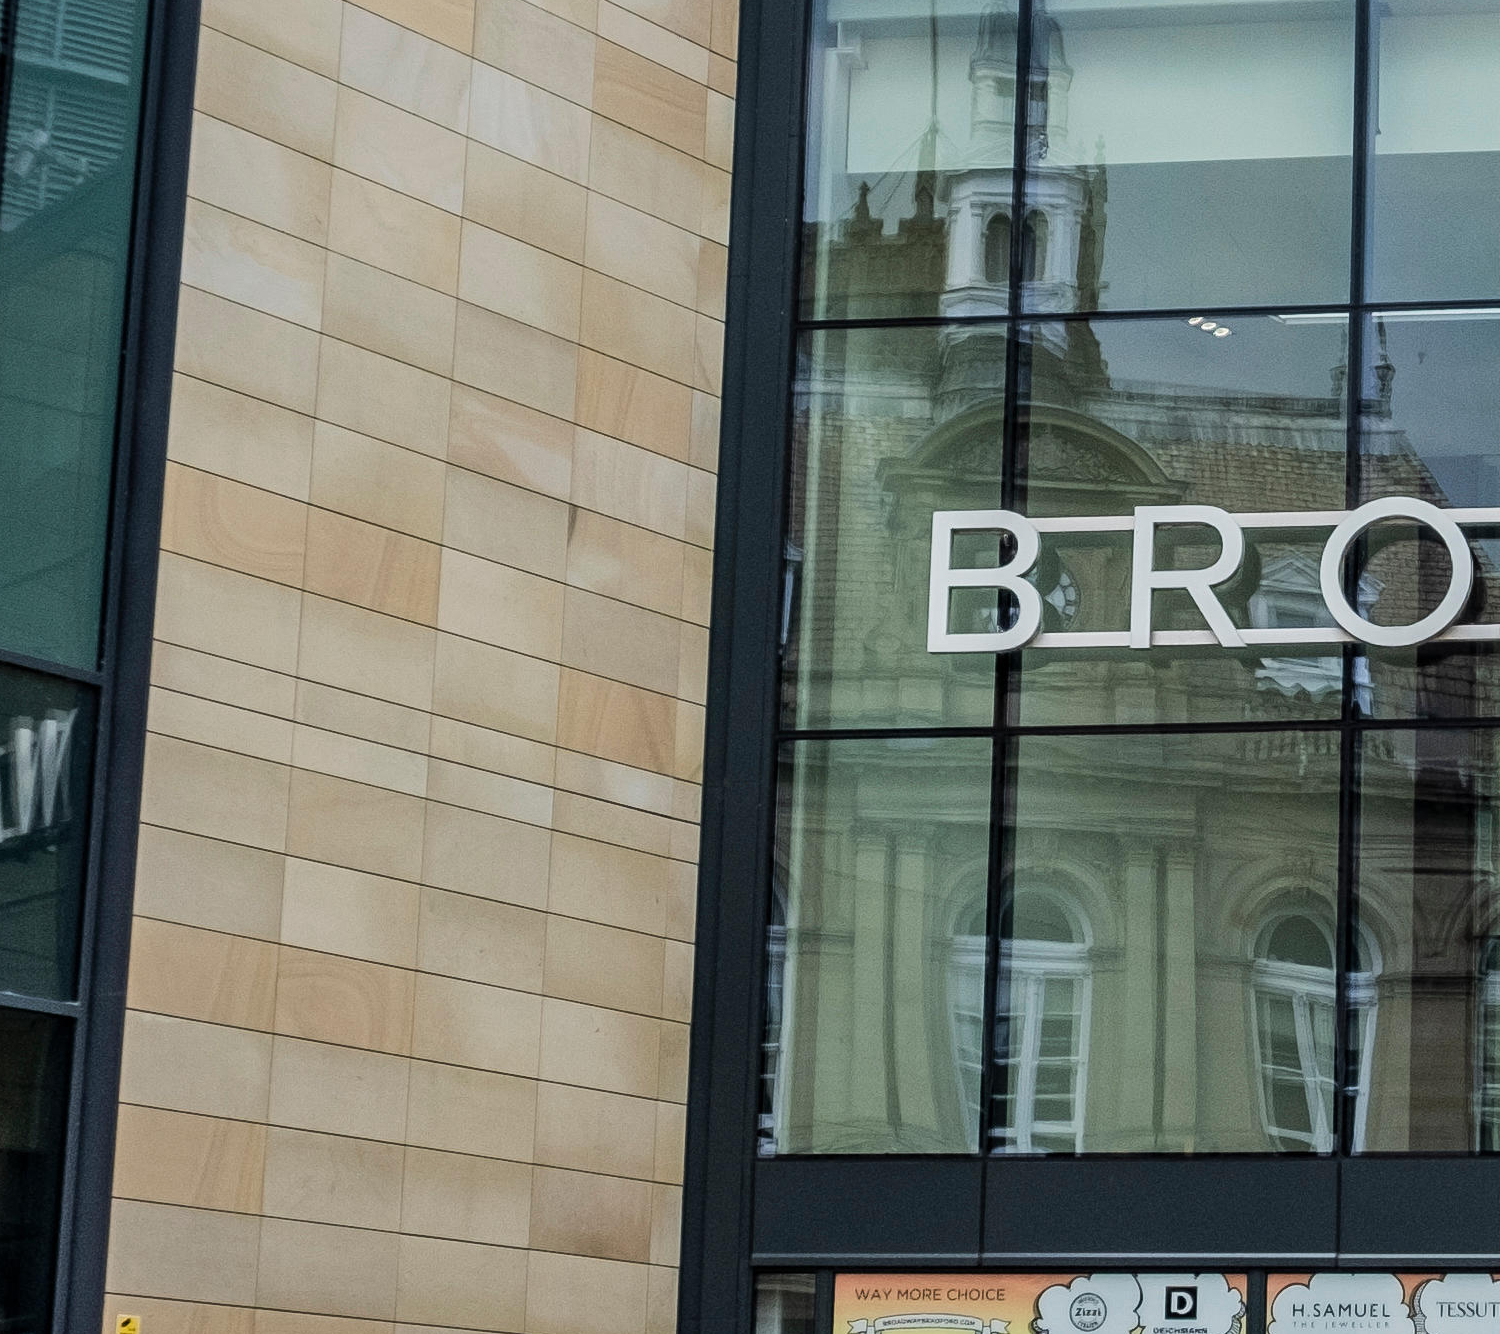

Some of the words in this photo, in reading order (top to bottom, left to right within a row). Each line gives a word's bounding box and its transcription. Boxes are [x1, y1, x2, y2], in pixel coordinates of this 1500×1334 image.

[855, 1287, 892, 1301] WAY
[897, 1287, 941, 1301] MORE
[946, 1287, 1006, 1302] CHOICE
[1170, 1291, 1194, 1315] D
[1075, 1307, 1102, 1317] Zizzi
[1292, 1321, 1319, 1329] THE
[1324, 1320, 1391, 1330] JEWELLER
[1152, 1327, 1208, 1334] DEICHMANN
